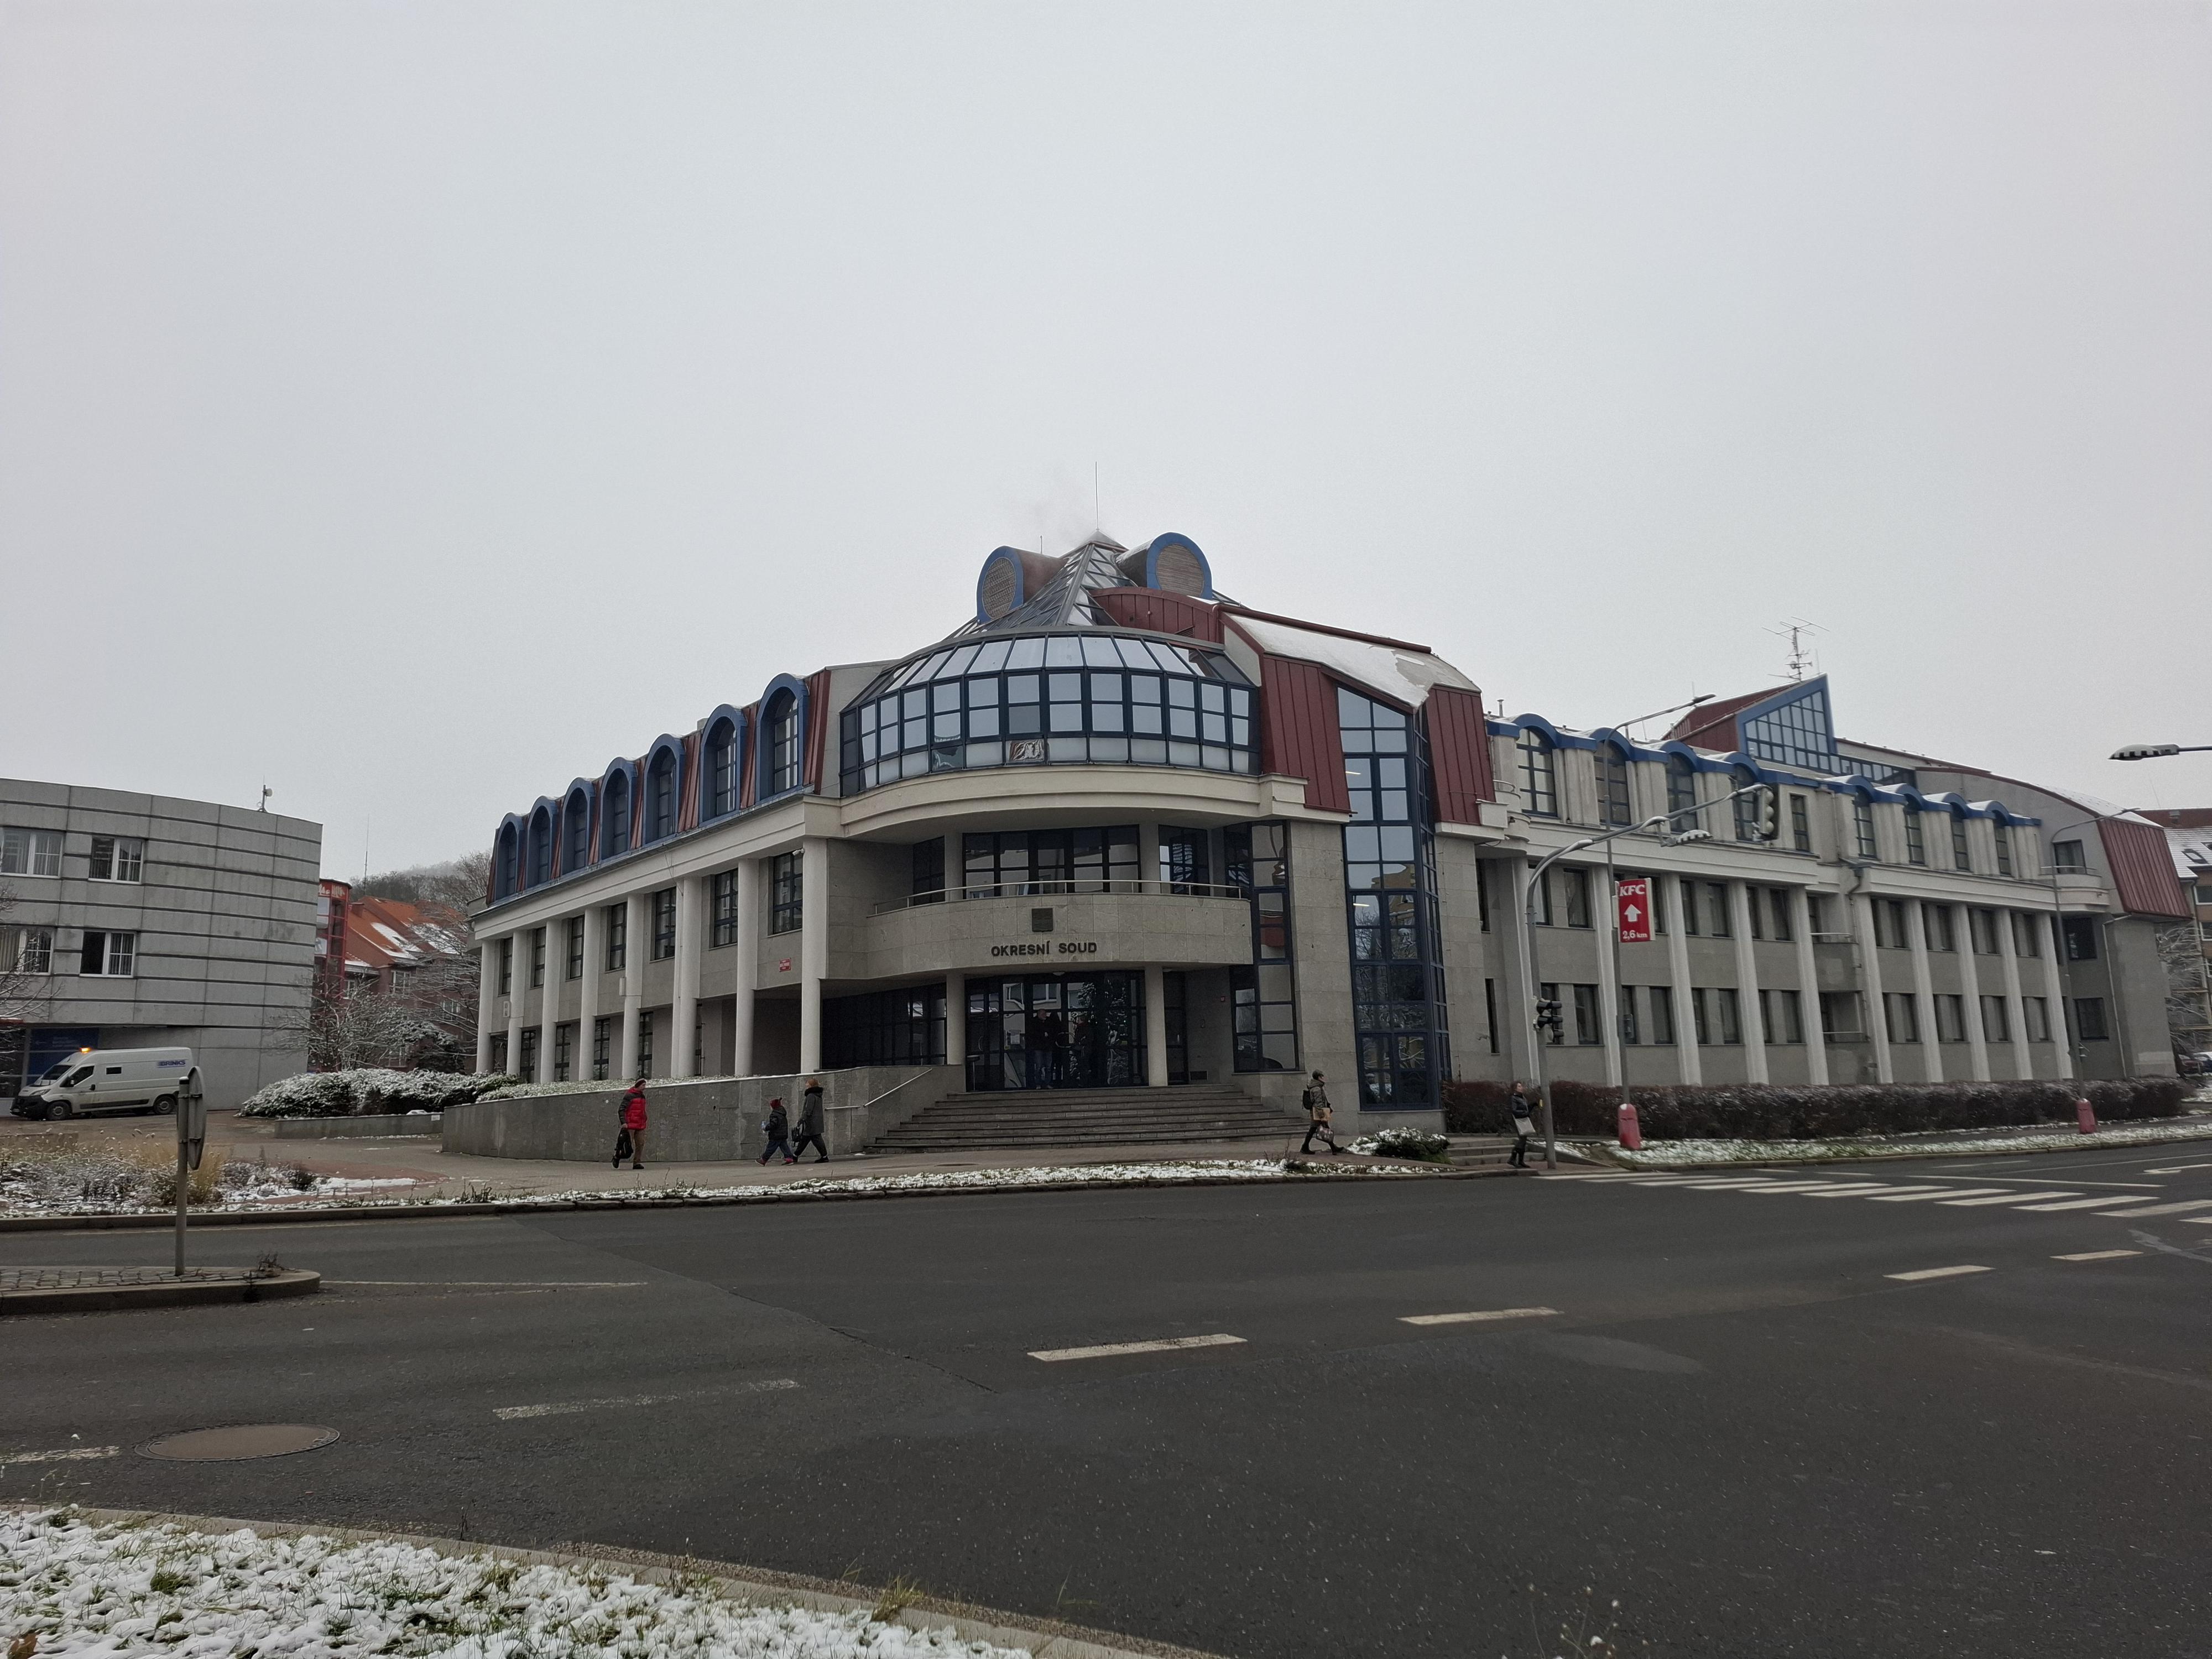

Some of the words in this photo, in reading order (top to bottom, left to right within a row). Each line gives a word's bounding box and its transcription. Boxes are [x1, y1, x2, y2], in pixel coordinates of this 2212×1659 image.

[1620, 884, 1645, 896] KFC
[1623, 930, 1636, 940] 2,6
[991, 941, 1050, 957] OKRESNÍ
[1058, 942, 1097, 953] SOUD
